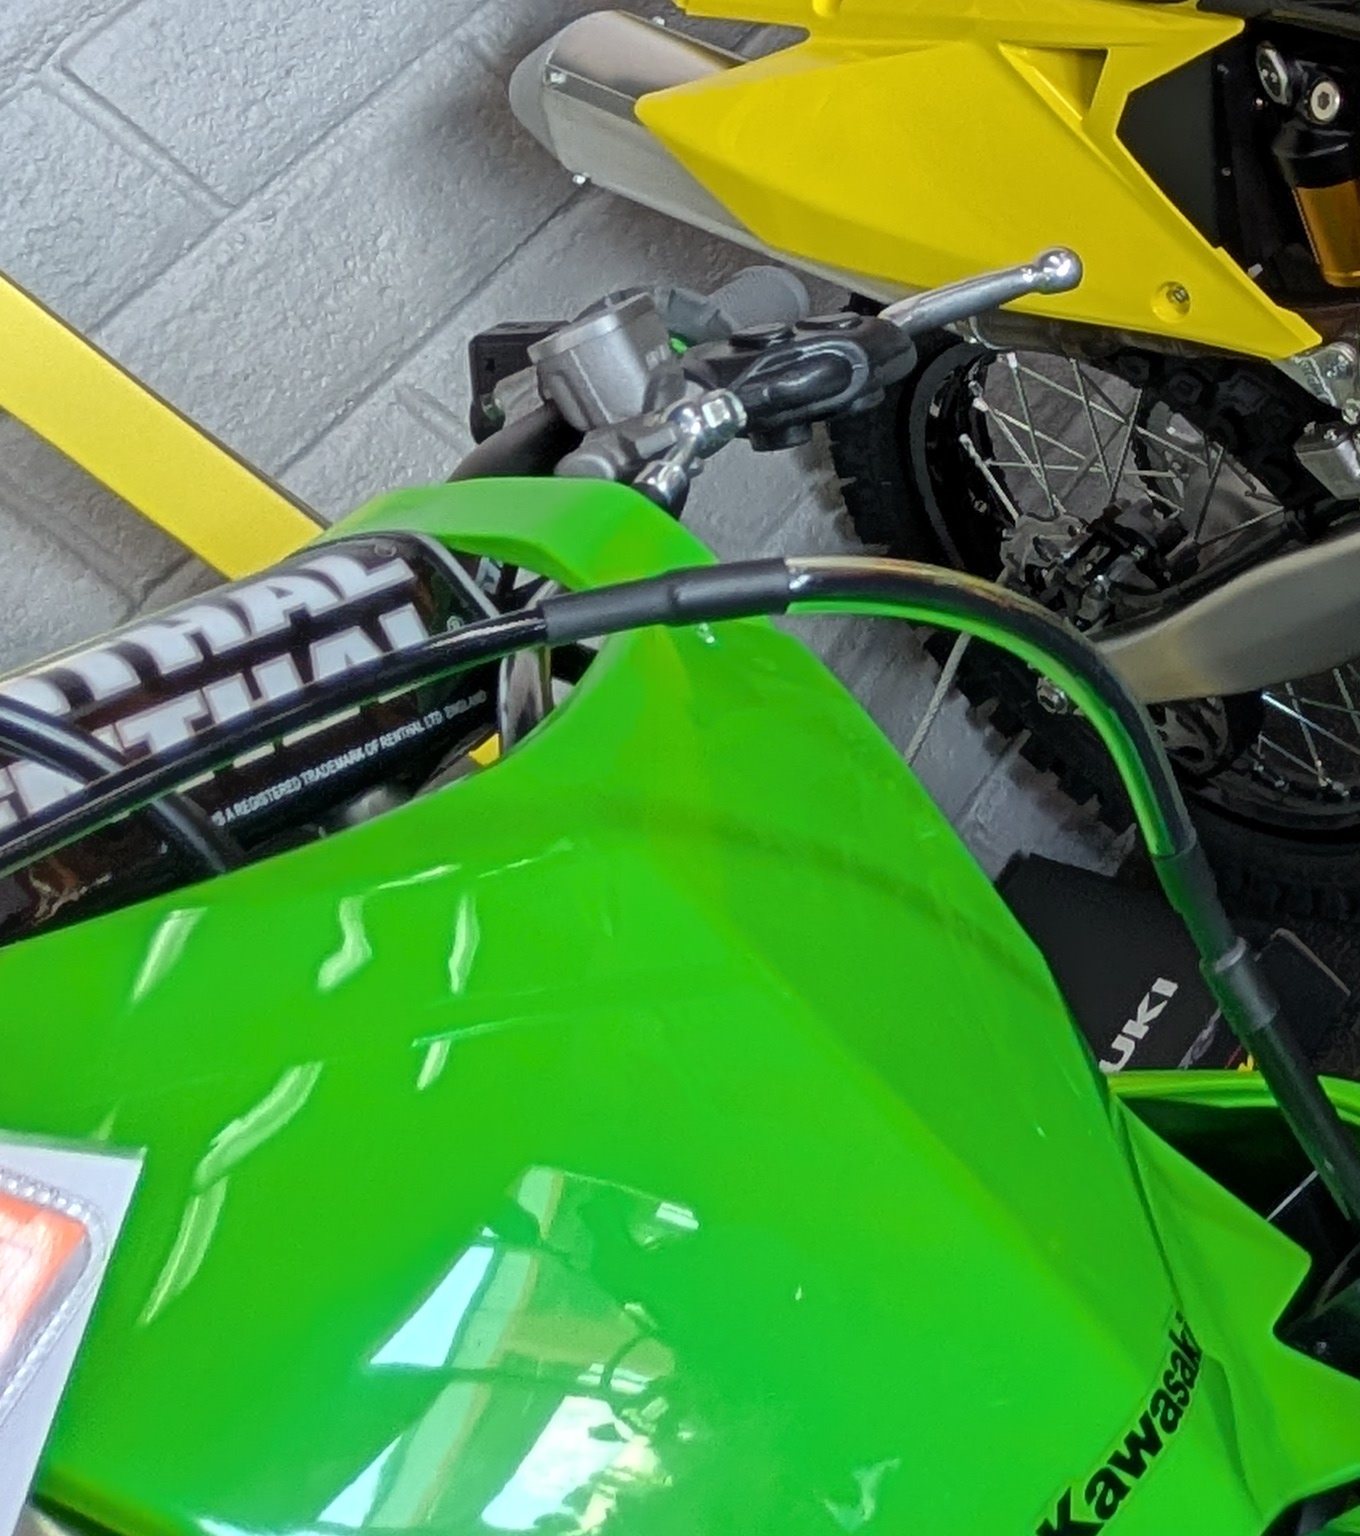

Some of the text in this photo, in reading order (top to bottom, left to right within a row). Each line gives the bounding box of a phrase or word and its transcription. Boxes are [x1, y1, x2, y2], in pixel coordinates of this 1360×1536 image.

[300, 746, 365, 791] TRADEMARK
[364, 738, 381, 757] OF
[1035, 1310, 1204, 1536] Kawasaki
